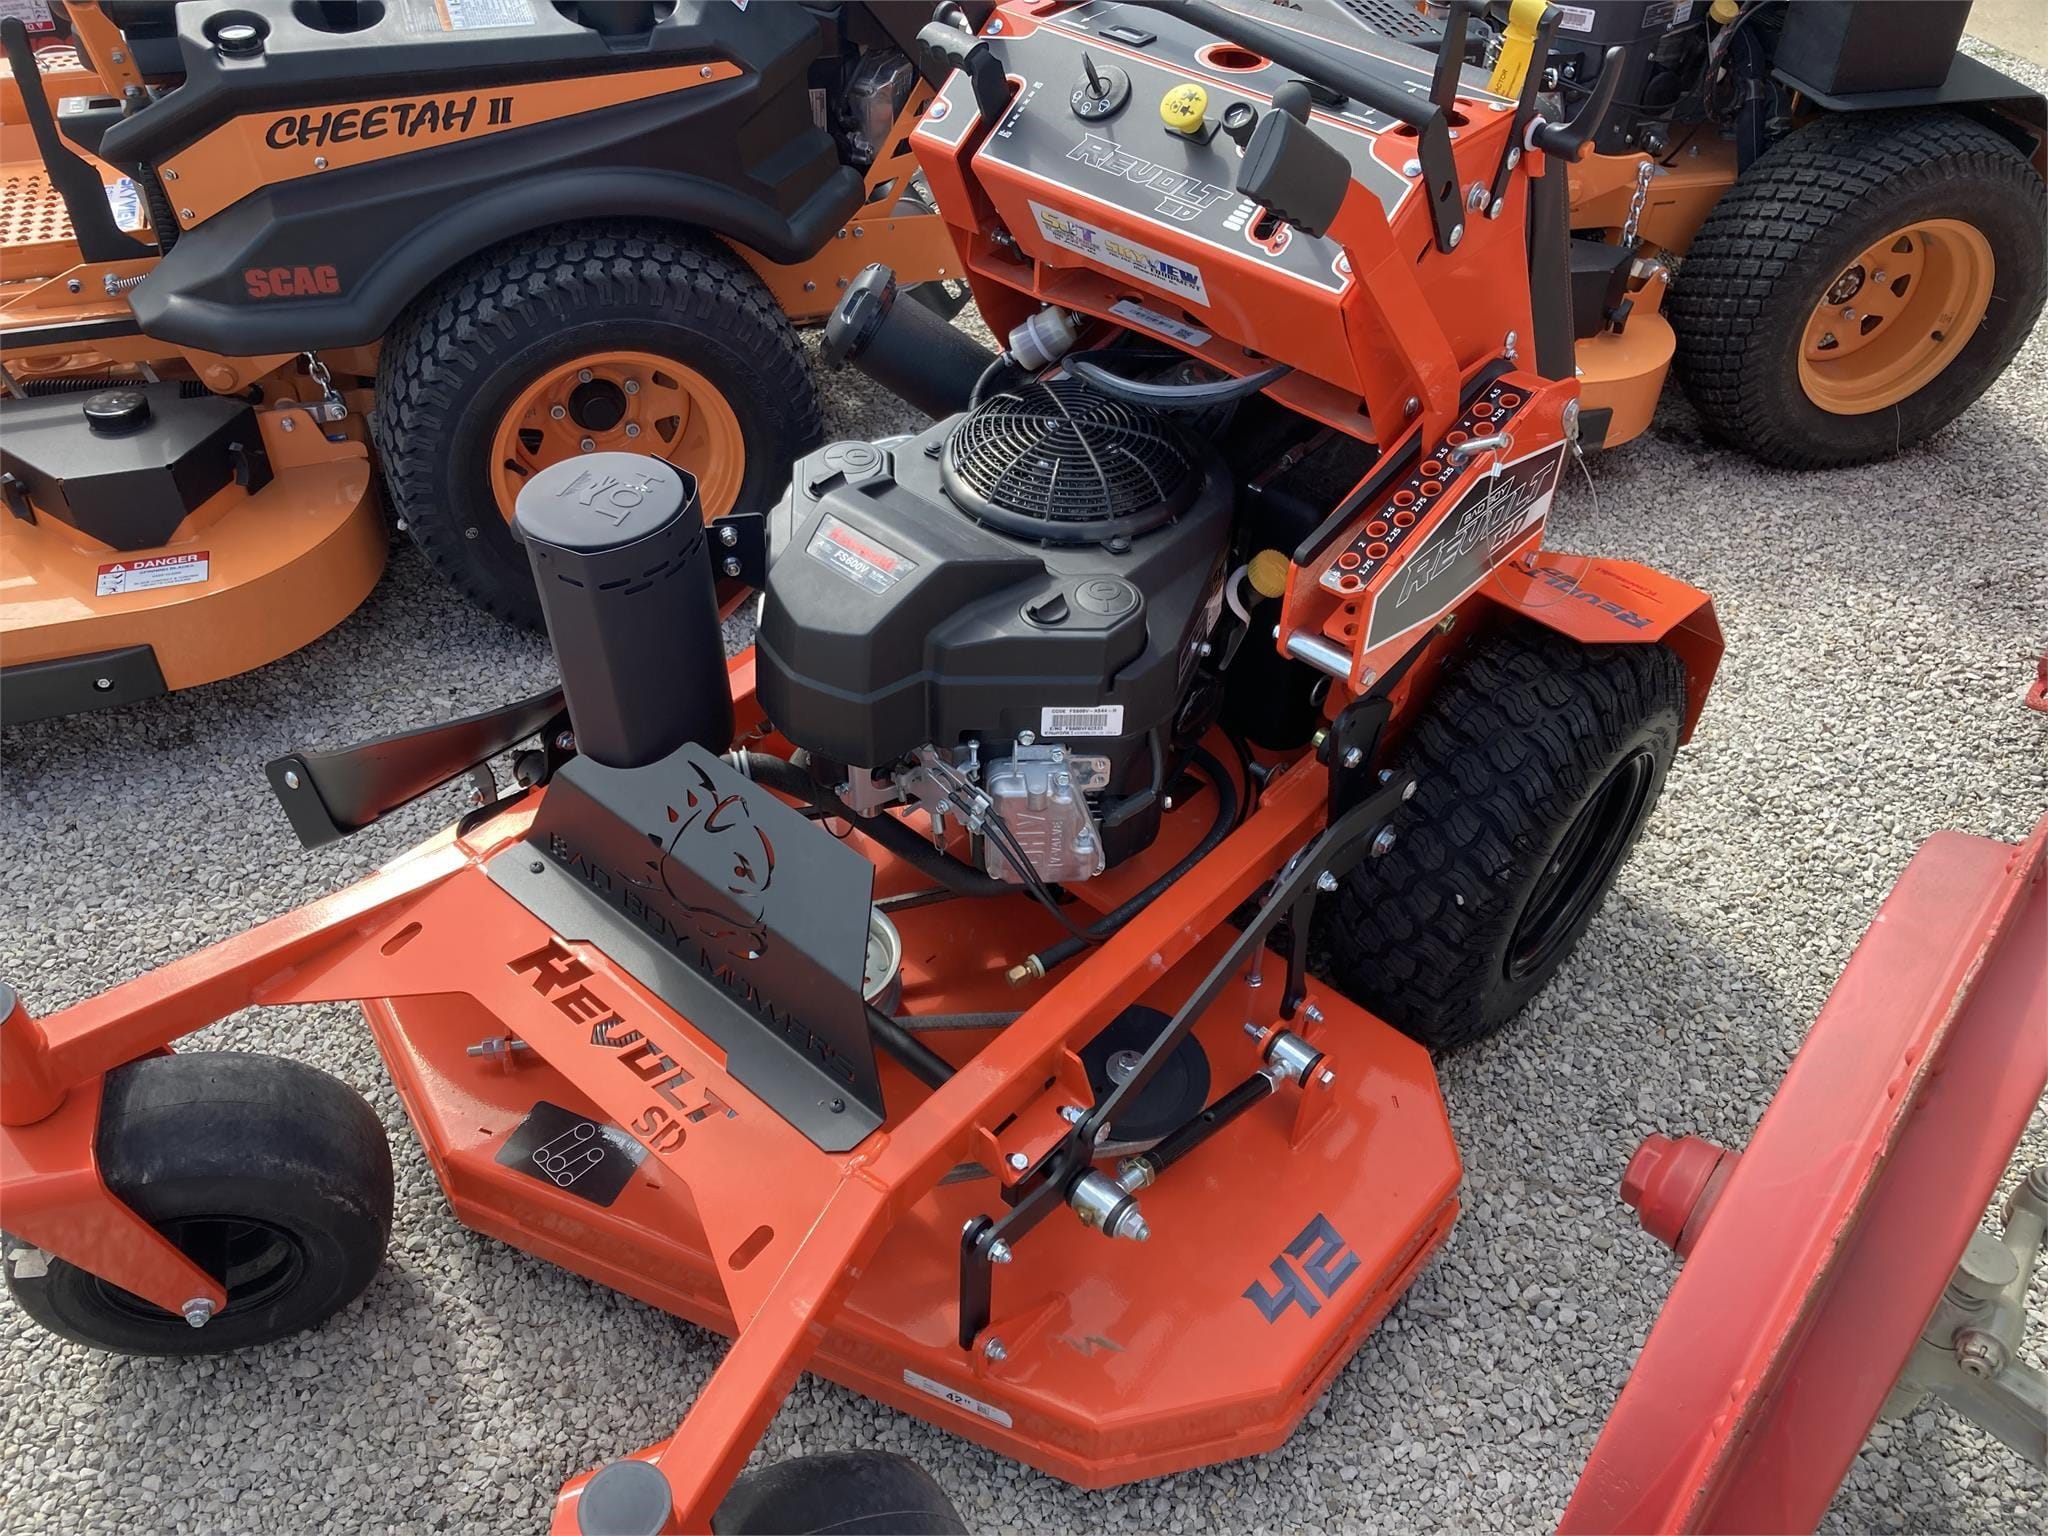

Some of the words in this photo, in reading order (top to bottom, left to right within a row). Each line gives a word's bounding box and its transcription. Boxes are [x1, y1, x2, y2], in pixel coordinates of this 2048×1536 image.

[265, 96, 478, 150] CHEETAH
[487, 97, 514, 125] II
[1066, 132, 1234, 208] REVOLT
[1104, 239, 1199, 286] SKYVIEW
[244, 265, 341, 298] SCAG
[1489, 388, 1502, 399] 4.5
[1490, 407, 1506, 422] 4.25
[1436, 447, 1449, 459] 3.5
[1438, 466, 1454, 482] 3.25
[1382, 506, 1396, 519] 2.5
[1411, 496, 1427, 513] 2.75
[1463, 502, 1486, 525] BAD
[1385, 527, 1401, 543] 2.25
[1395, 459, 1556, 608] REVOLT
[133, 553, 199, 570] DANGER
[833, 549, 871, 574] FS600V
[1358, 559, 1375, 575] 1.75
[1508, 560, 1655, 630] REVOLT
[550, 831, 612, 892] BAD
[624, 888, 690, 947] BOY
[700, 947, 856, 1083] MOWERS
[506, 936, 739, 1124] REVOLT
[630, 1105, 687, 1156] SD
[1240, 1211, 1362, 1325] 42
